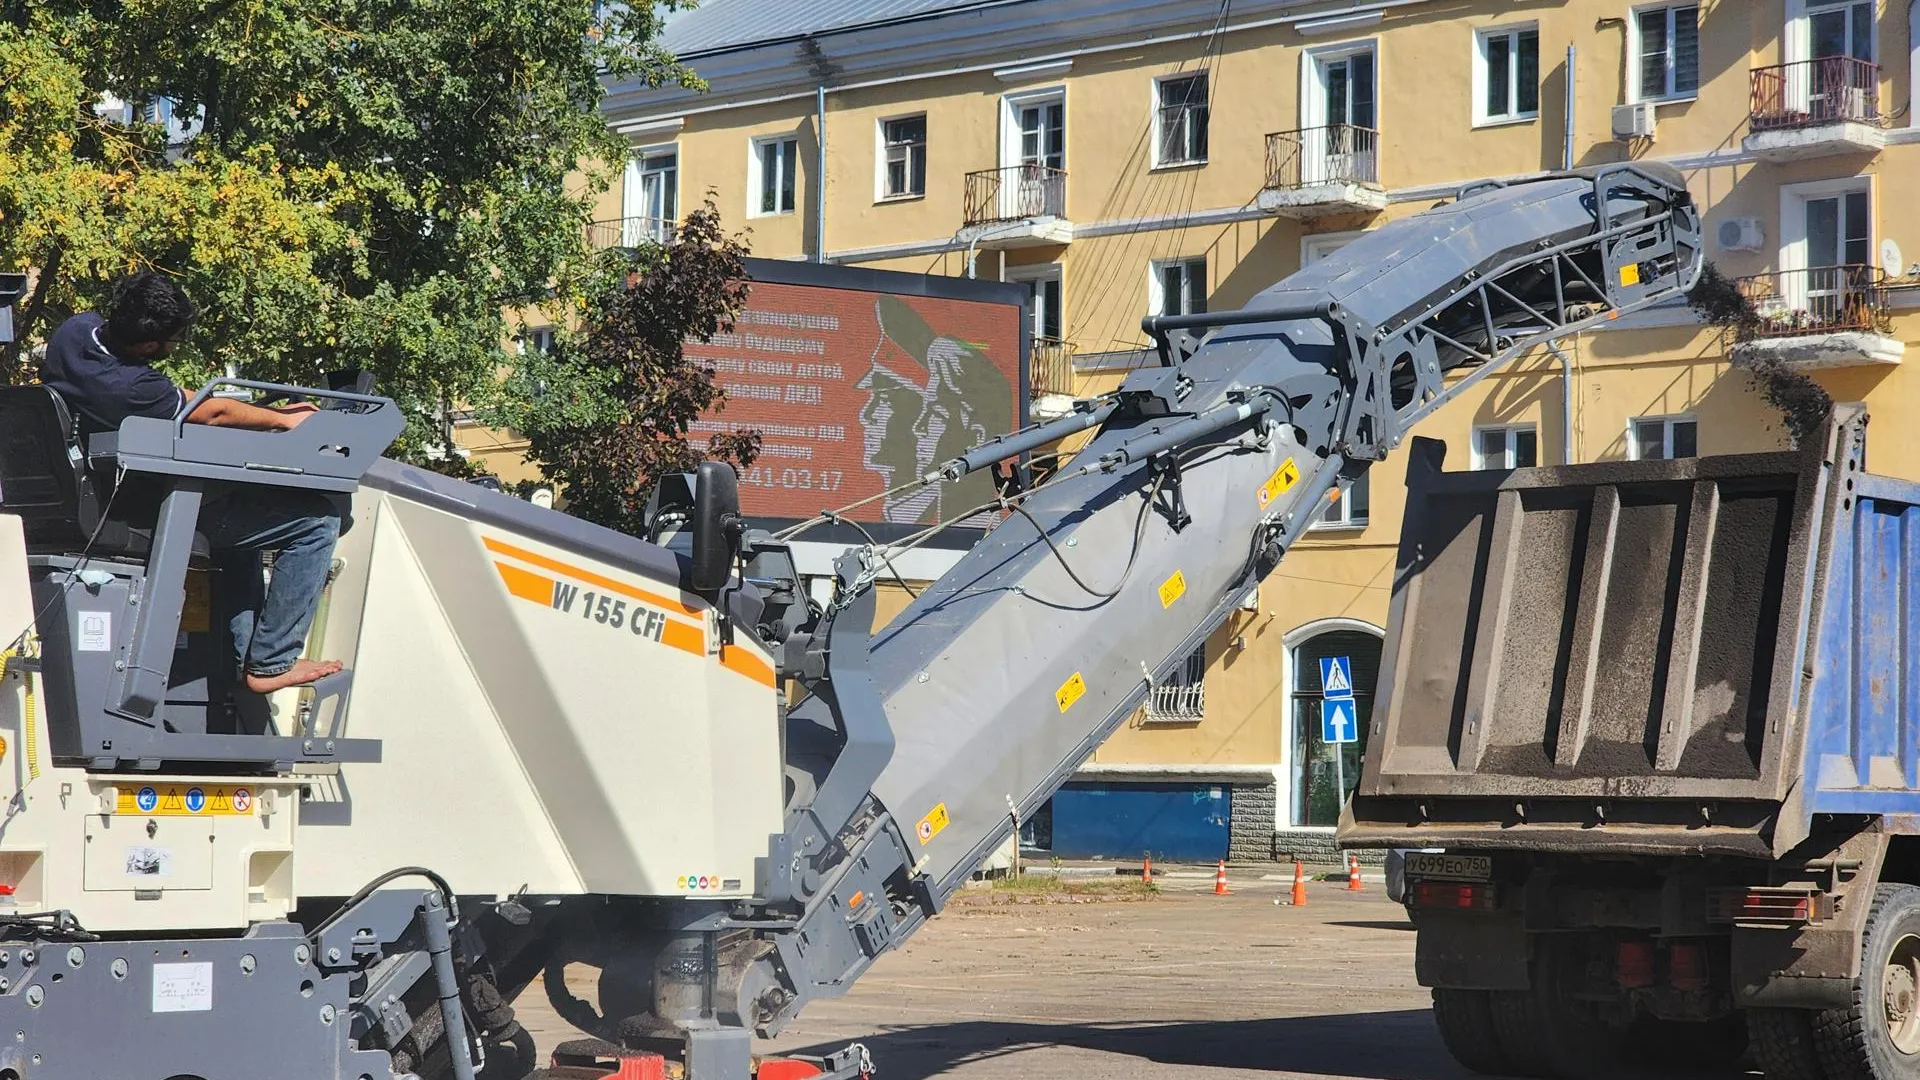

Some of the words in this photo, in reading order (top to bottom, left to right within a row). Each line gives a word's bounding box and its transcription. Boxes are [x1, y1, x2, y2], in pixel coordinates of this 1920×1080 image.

[552, 581, 579, 613] W
[583, 591, 627, 629] 155
[630, 606, 666, 643] CFi
